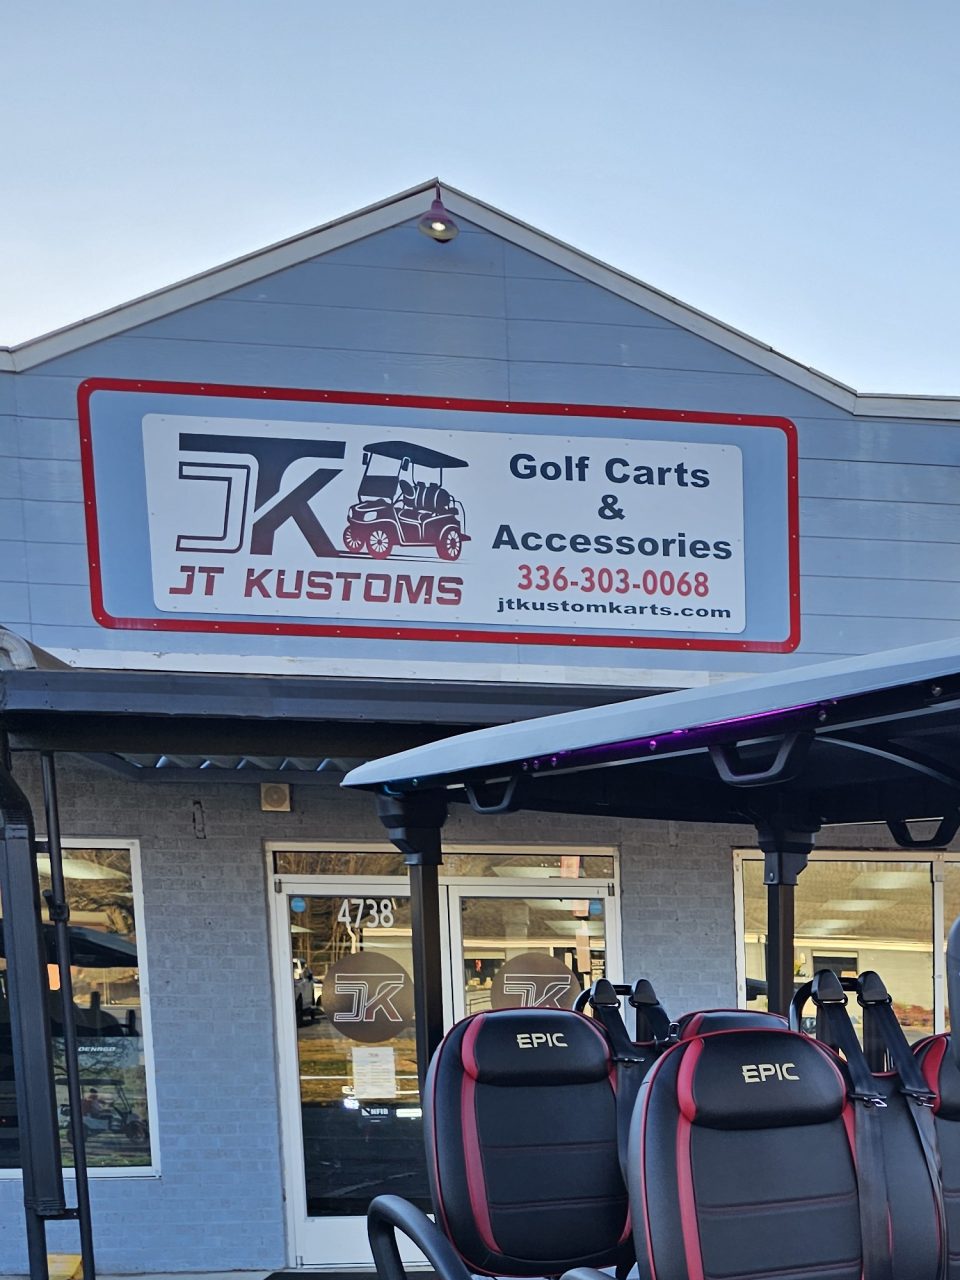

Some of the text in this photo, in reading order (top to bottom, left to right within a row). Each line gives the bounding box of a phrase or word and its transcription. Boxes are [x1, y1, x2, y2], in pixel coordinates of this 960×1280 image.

[509, 454, 711, 489] Golf Carts
[597, 495, 626, 520] &
[491, 525, 733, 560] Accessories
[169, 565, 465, 607] JT KUSTOMS
[517, 565, 711, 598] 336-303-0068
[497, 598, 733, 620] jtkustomkarts.com
[337, 898, 395, 929] 4738
[516, 1032, 569, 1049] EPIC
[741, 1062, 800, 1083] EPIC
